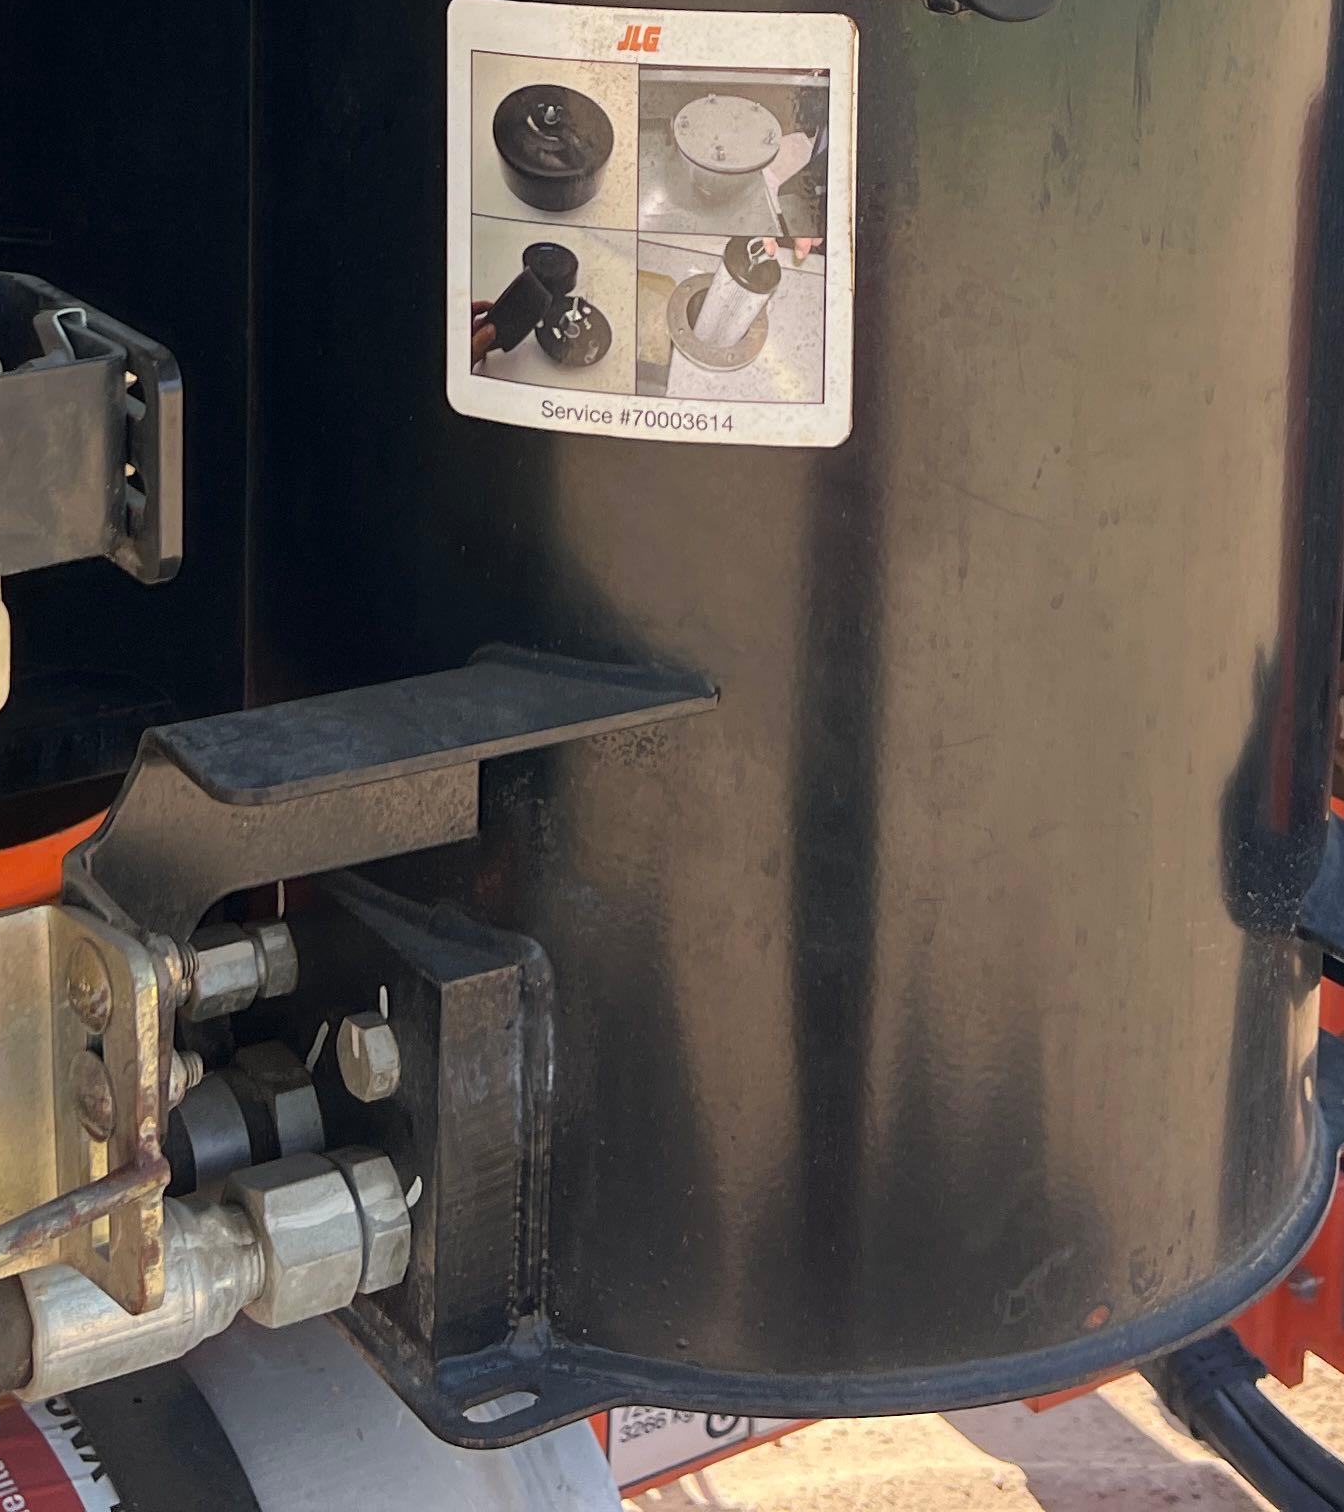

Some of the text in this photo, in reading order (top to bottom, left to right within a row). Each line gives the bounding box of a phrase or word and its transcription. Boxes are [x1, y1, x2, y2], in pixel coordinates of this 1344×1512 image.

[617, 25, 662, 53] JLG
[541, 400, 734, 432] Service #70003614
